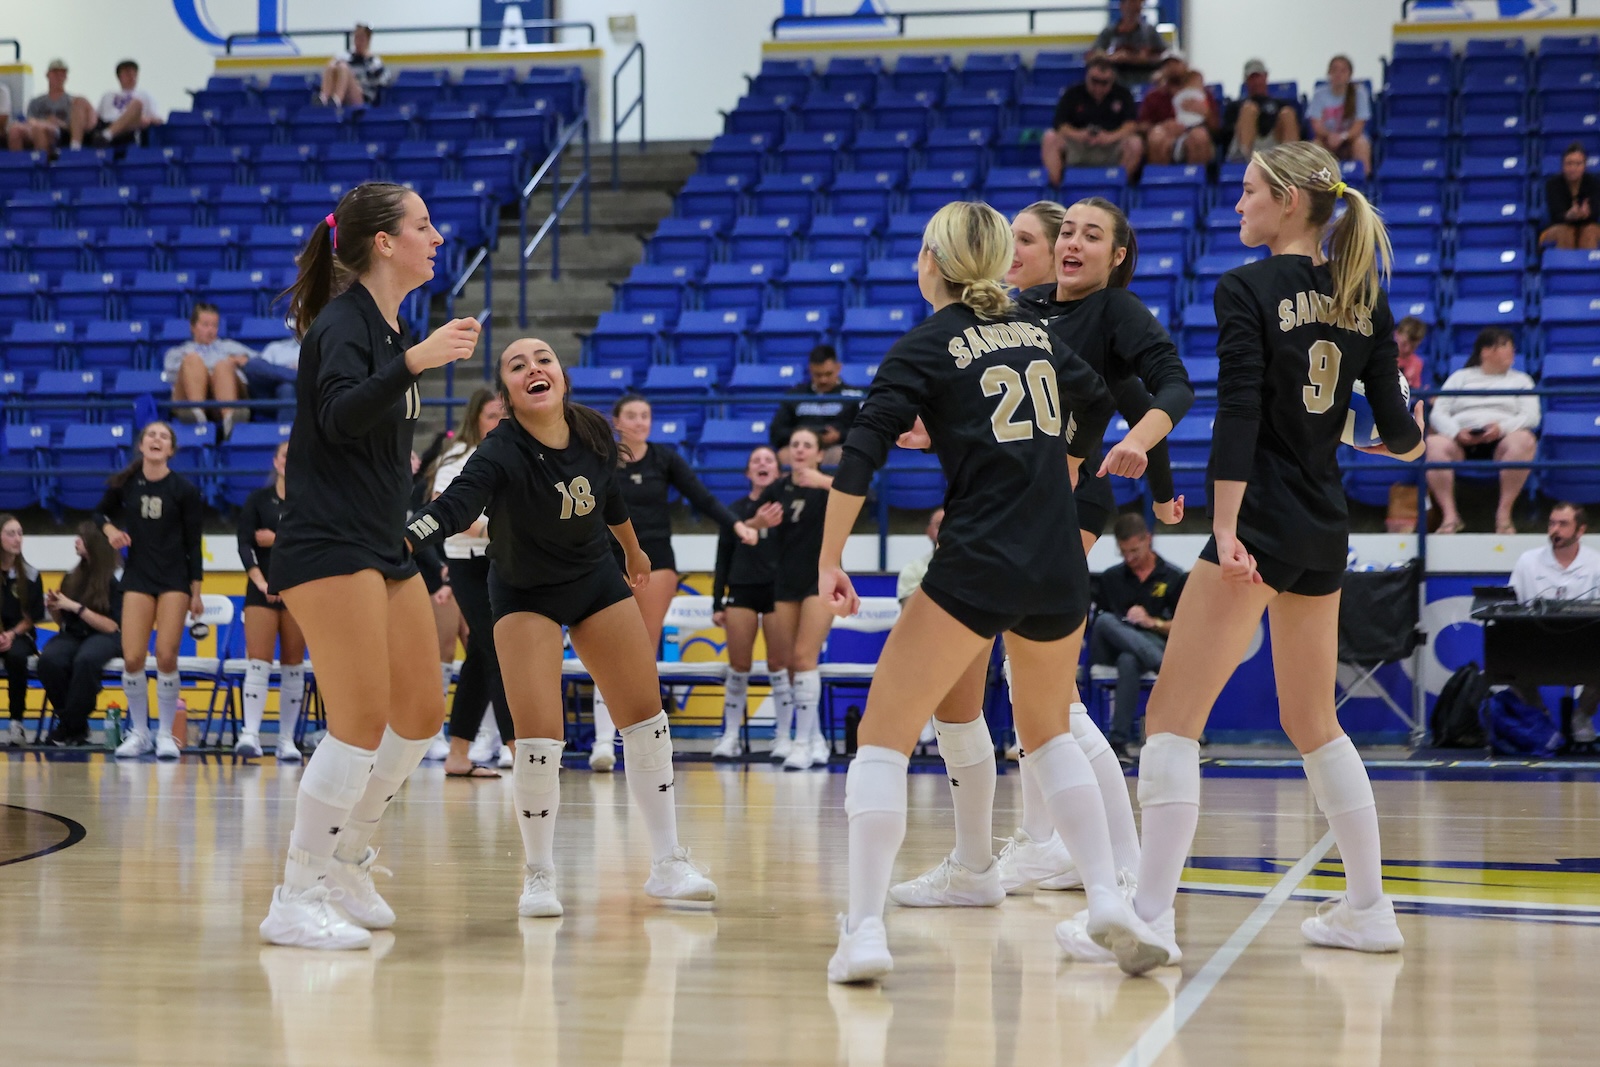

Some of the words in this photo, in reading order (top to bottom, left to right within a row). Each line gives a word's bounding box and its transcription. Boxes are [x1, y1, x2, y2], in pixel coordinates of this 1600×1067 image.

[979, 359, 1062, 443] 20
[1302, 339, 1343, 415] 9
[554, 475, 596, 520] 18
[790, 498, 806, 523] 7
